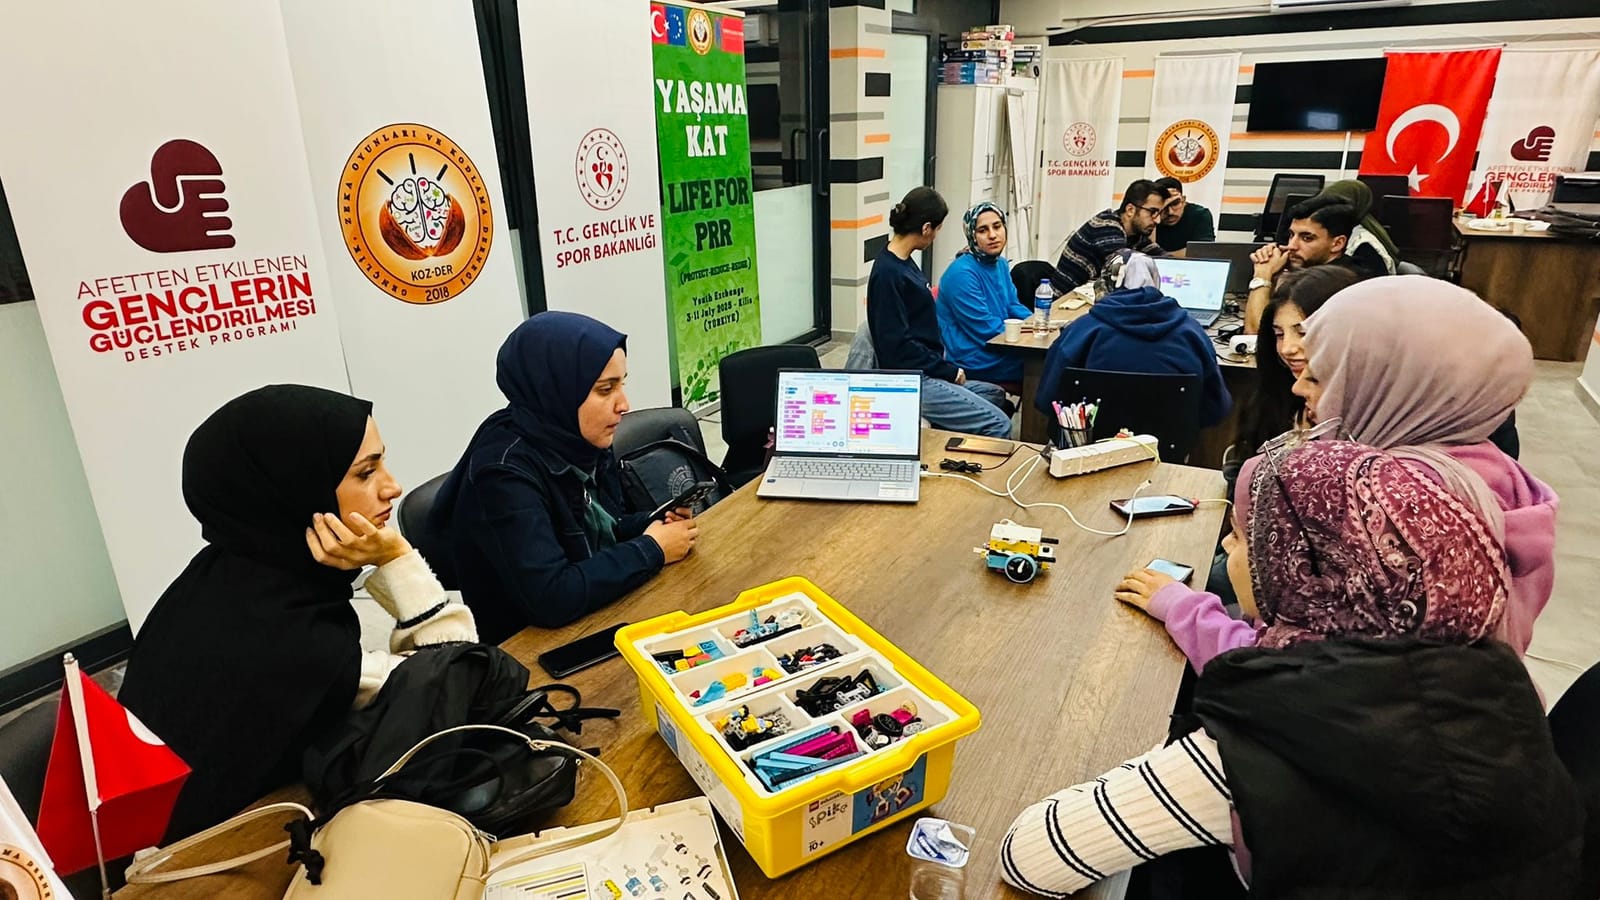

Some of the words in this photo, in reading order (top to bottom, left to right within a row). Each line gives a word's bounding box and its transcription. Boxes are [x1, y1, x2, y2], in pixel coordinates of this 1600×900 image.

[655, 79, 748, 121] YAŞAMA
[685, 125, 728, 157] KAT
[344, 181, 353, 225] ZEKA
[351, 130, 417, 171] OYUNLARI
[426, 133, 442, 146] VE
[449, 147, 488, 215] KODLAMA
[667, 179, 713, 214] LIFE
[715, 177, 750, 207] FOR
[553, 227, 579, 245] T.C.
[582, 214, 637, 239] GENÇLİK
[639, 214, 655, 229] VE
[695, 219, 733, 251] PRR
[556, 247, 591, 268] SPOR
[593, 232, 656, 260] BAKANLIĞI
[77, 268, 189, 300] AFETTEN
[411, 264, 454, 281] KOZ-DER
[425, 286, 450, 302] 2018
[692, 293, 713, 306] Youth
[714, 286, 744, 301] Exchange
[700, 306, 715, 318] July
[125, 338, 200, 362] DESTEK
[210, 320, 297, 345] PROGRAMI
